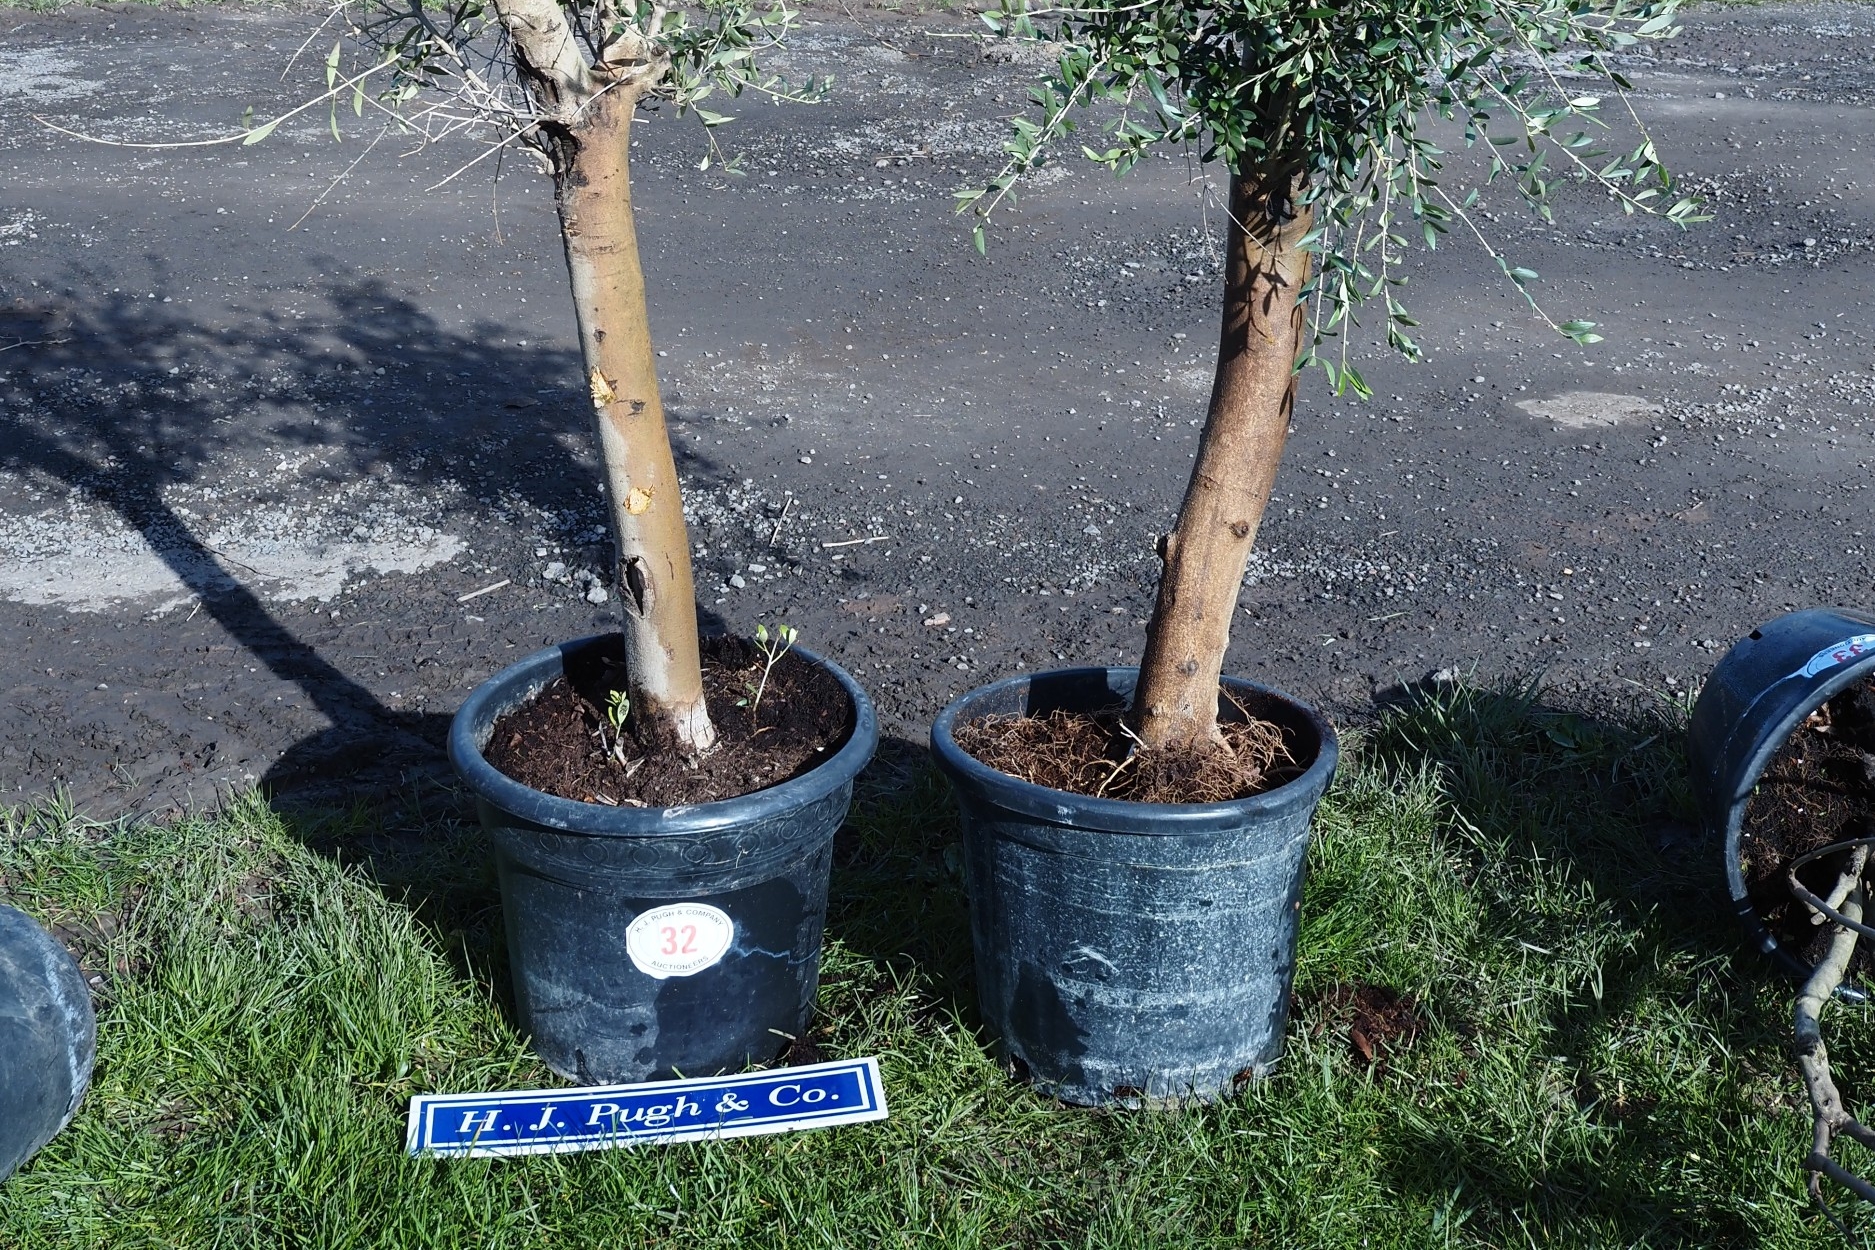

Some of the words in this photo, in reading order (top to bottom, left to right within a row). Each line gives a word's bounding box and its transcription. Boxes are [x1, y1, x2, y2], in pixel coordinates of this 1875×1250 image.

[651, 911, 675, 921] PUGH
[686, 909, 724, 926] COMPANY
[661, 925, 698, 955] 32
[651, 956, 709, 970] AUCTIONEERS
[455, 1110, 511, 1132] H.
[529, 1107, 565, 1131] J.
[585, 1096, 702, 1127] Pugh
[715, 1093, 749, 1113] &
[769, 1084, 839, 1106] Co.
